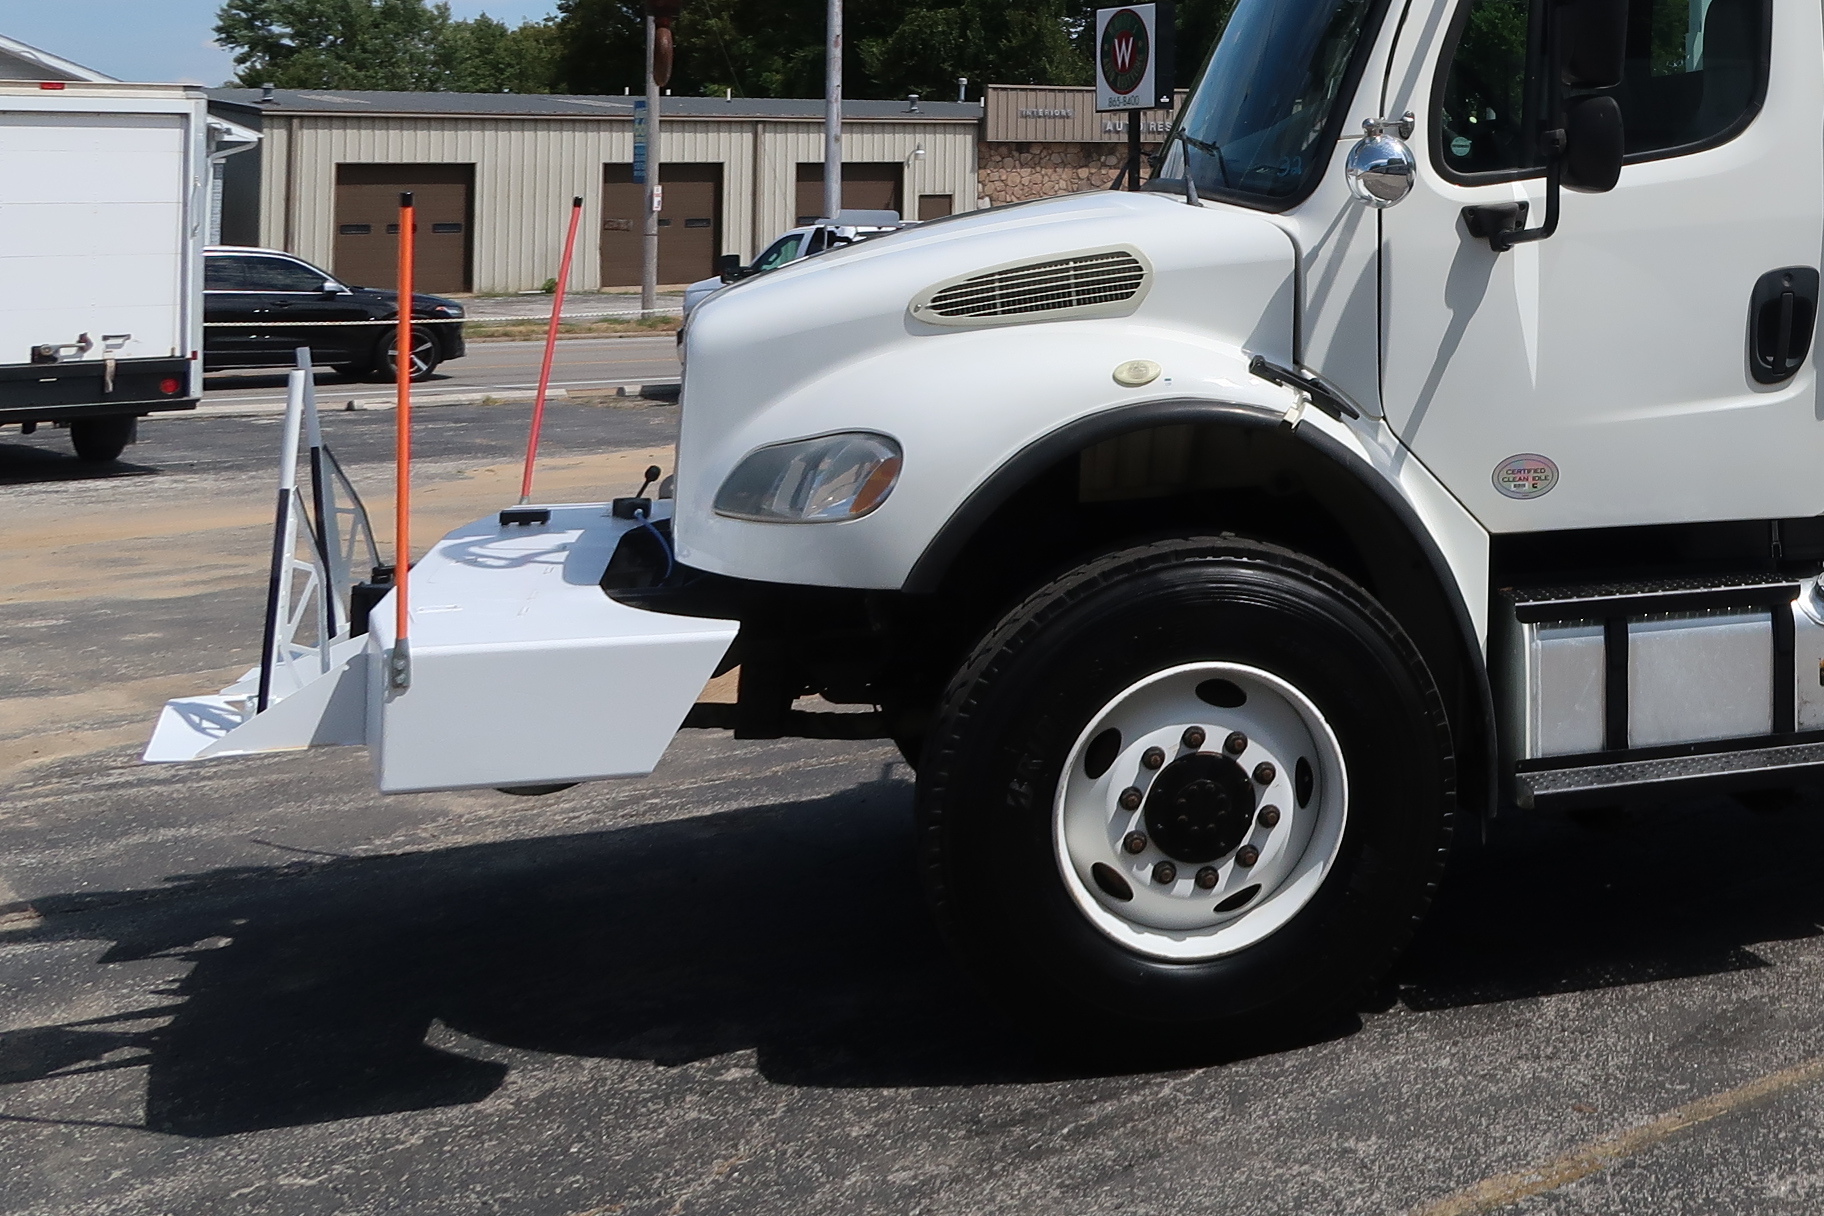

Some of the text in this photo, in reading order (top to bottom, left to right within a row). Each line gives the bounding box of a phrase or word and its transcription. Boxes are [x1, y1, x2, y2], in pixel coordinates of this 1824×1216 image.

[1114, 36, 1134, 70] W
[1108, 95, 1140, 107] 865-8400
[1021, 108, 1073, 119] INTERIORS
